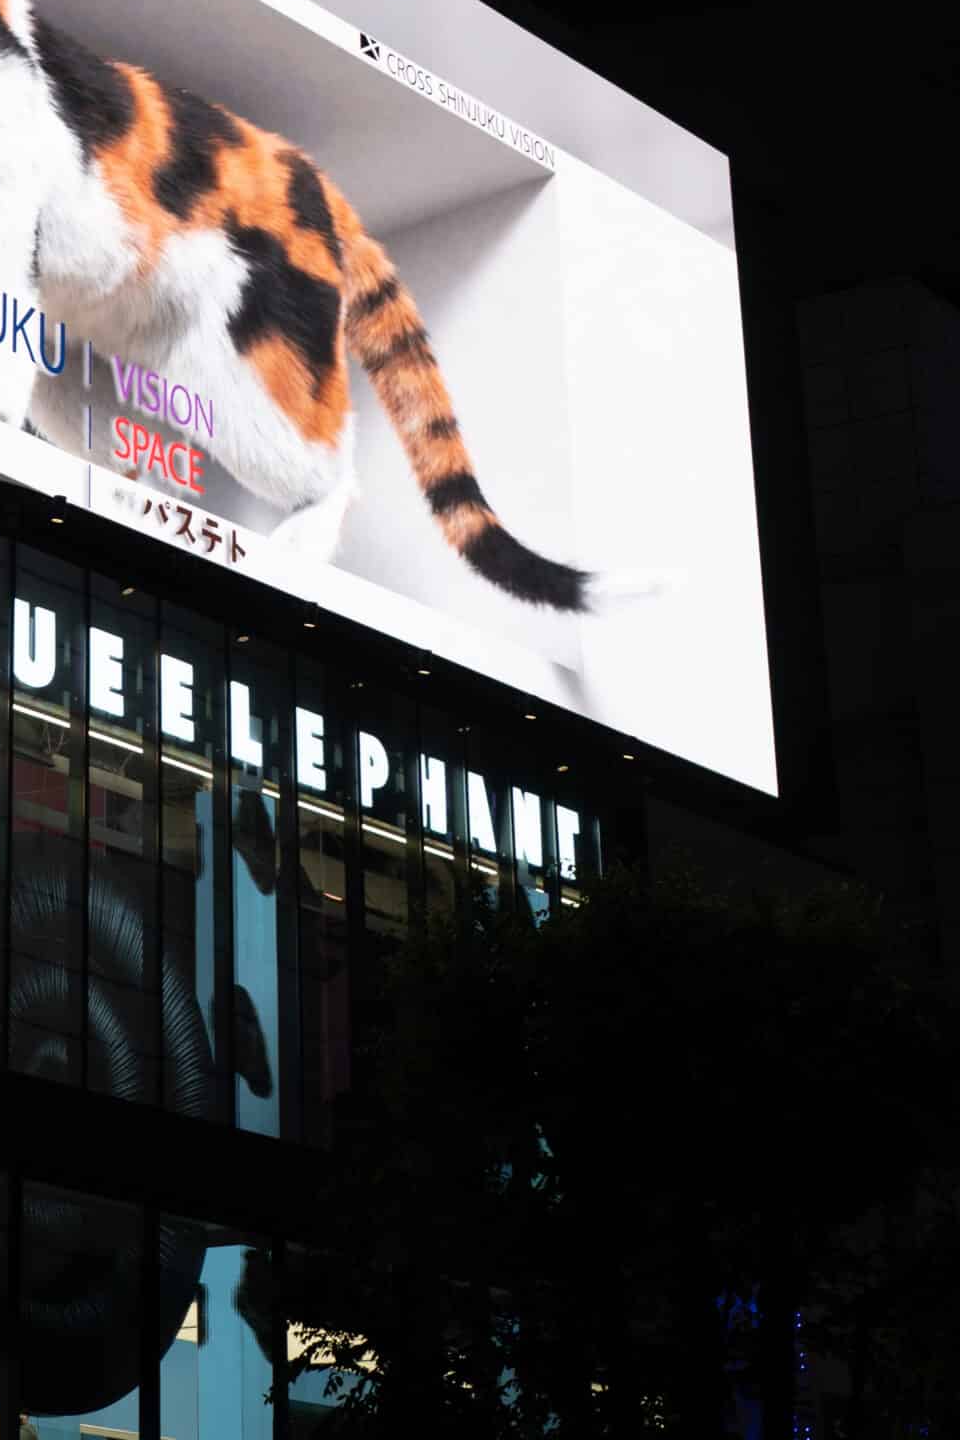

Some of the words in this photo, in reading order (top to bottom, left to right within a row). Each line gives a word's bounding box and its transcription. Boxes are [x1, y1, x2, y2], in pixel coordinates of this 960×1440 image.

[386, 53, 433, 96] CROSS
[438, 81, 506, 139] SHINJUKU
[510, 123, 556, 168] VISION
[113, 355, 215, 438] VISION
[113, 416, 207, 495] SPACE
[160, 654, 581, 881] ELEPHANT
